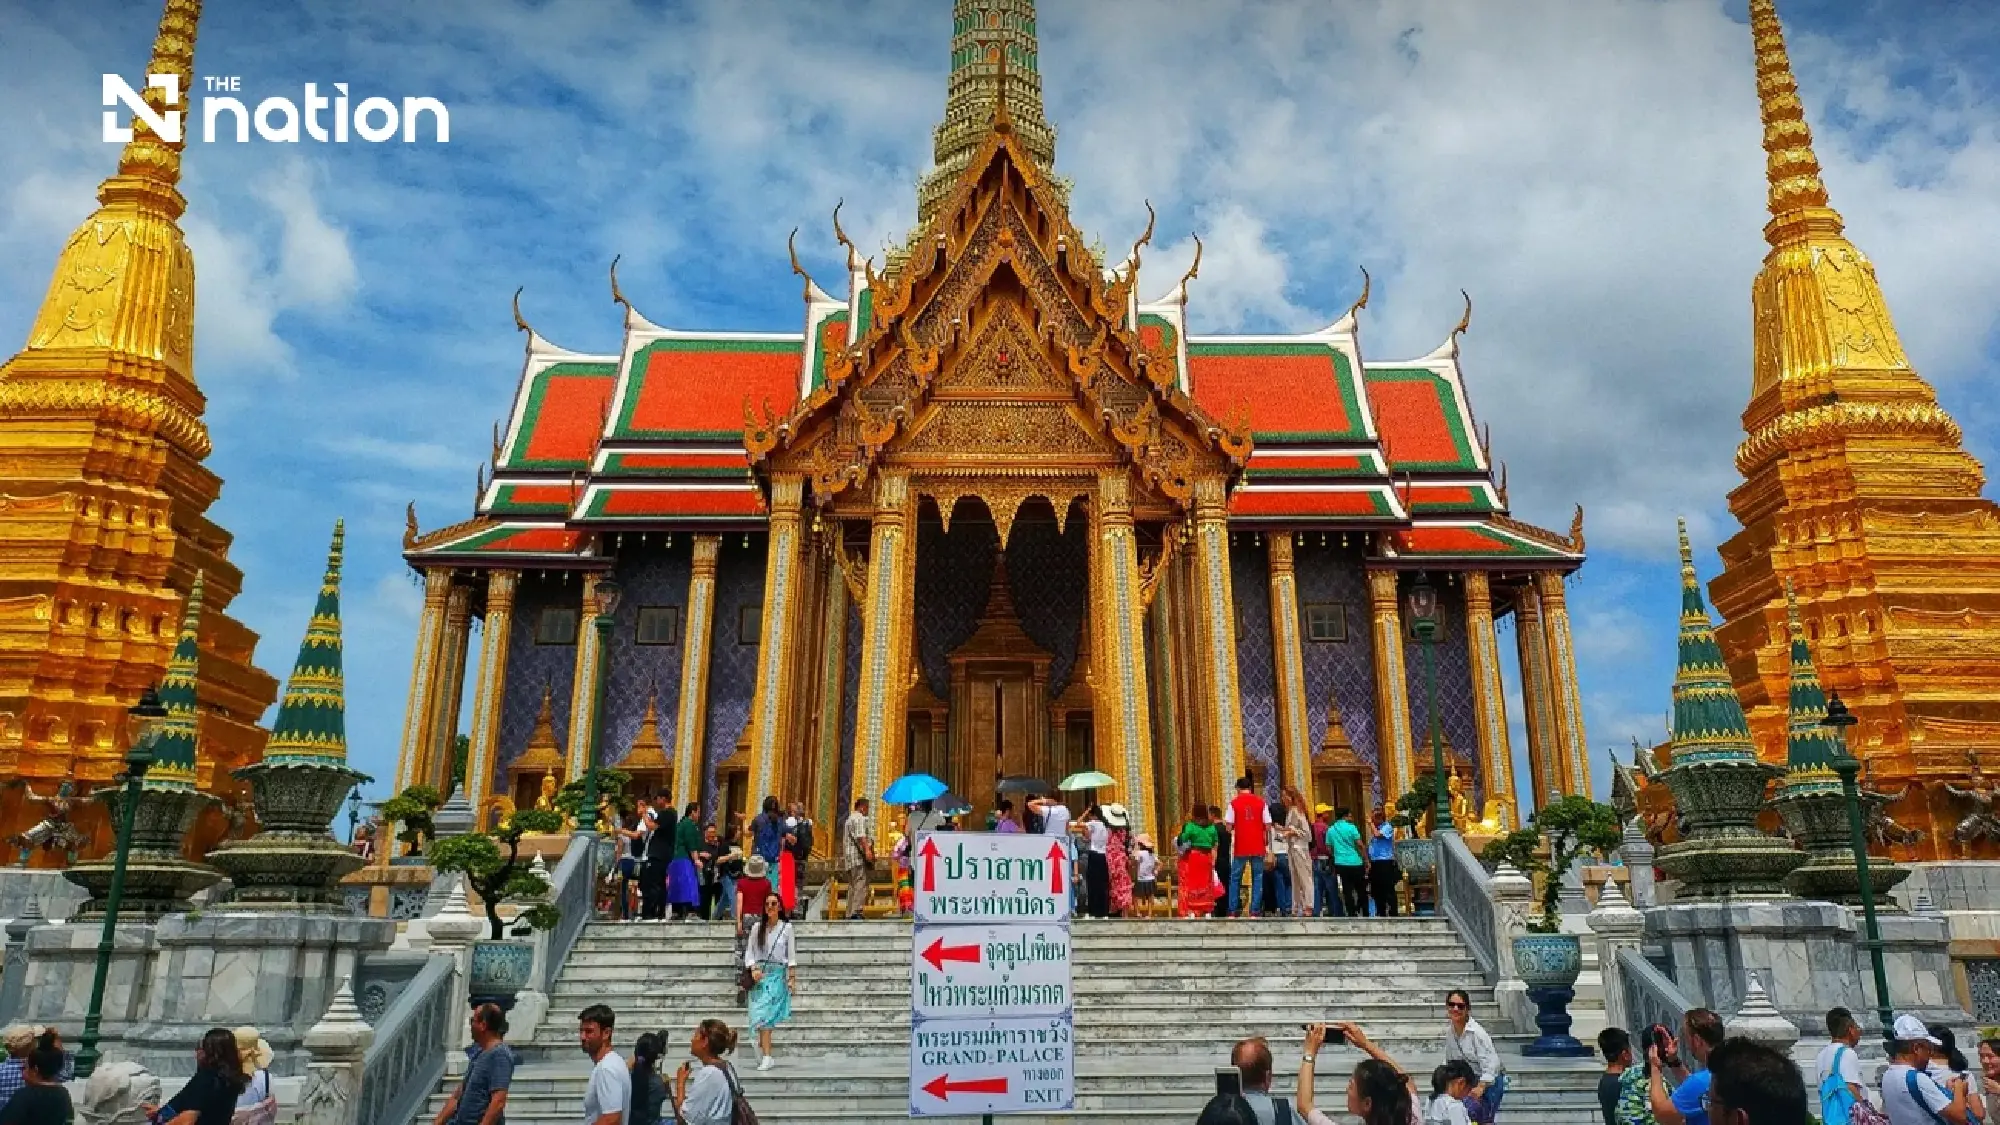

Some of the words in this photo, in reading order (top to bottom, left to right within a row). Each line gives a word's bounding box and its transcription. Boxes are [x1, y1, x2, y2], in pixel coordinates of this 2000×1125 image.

[944, 842, 1043, 880] ปราสาท
[930, 887, 1055, 915] พระเทพบิดร
[918, 972, 1064, 1007] ไหว้พระแก้วมรกต
[916, 1020, 1069, 1048] พระบรมมหาราชวัง
[921, 1050, 987, 1065] GRAND
[997, 1047, 1065, 1063] PALACE
[1022, 1067, 1064, 1081] ทางออก
[1024, 1089, 1064, 1103] EXIT
